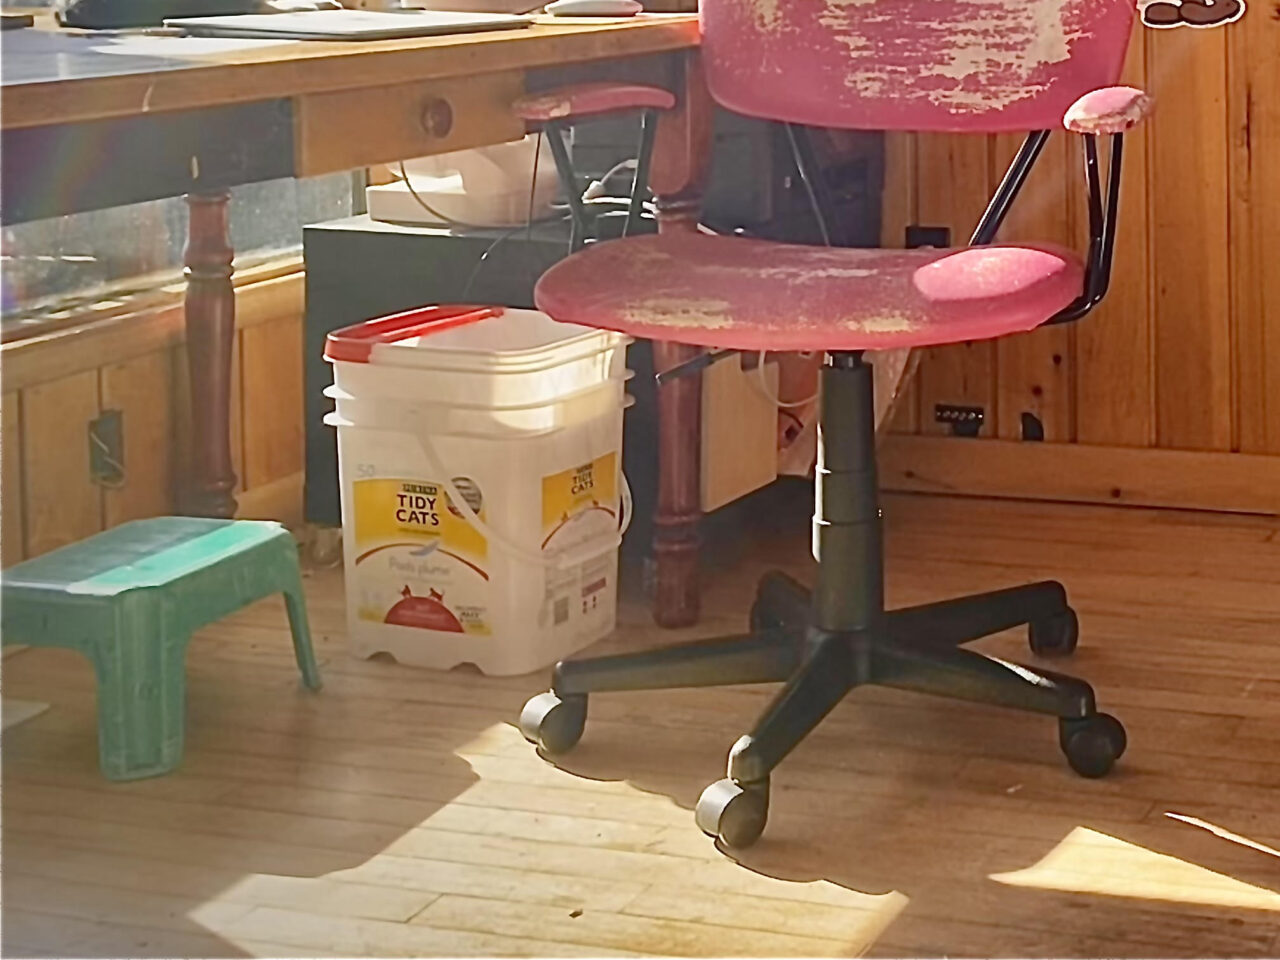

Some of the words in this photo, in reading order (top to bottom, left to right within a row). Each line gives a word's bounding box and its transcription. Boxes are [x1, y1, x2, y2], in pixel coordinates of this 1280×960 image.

[570, 480, 594, 496] CATS
[396, 493, 437, 511] TIDY
[395, 509, 440, 526] CATS
